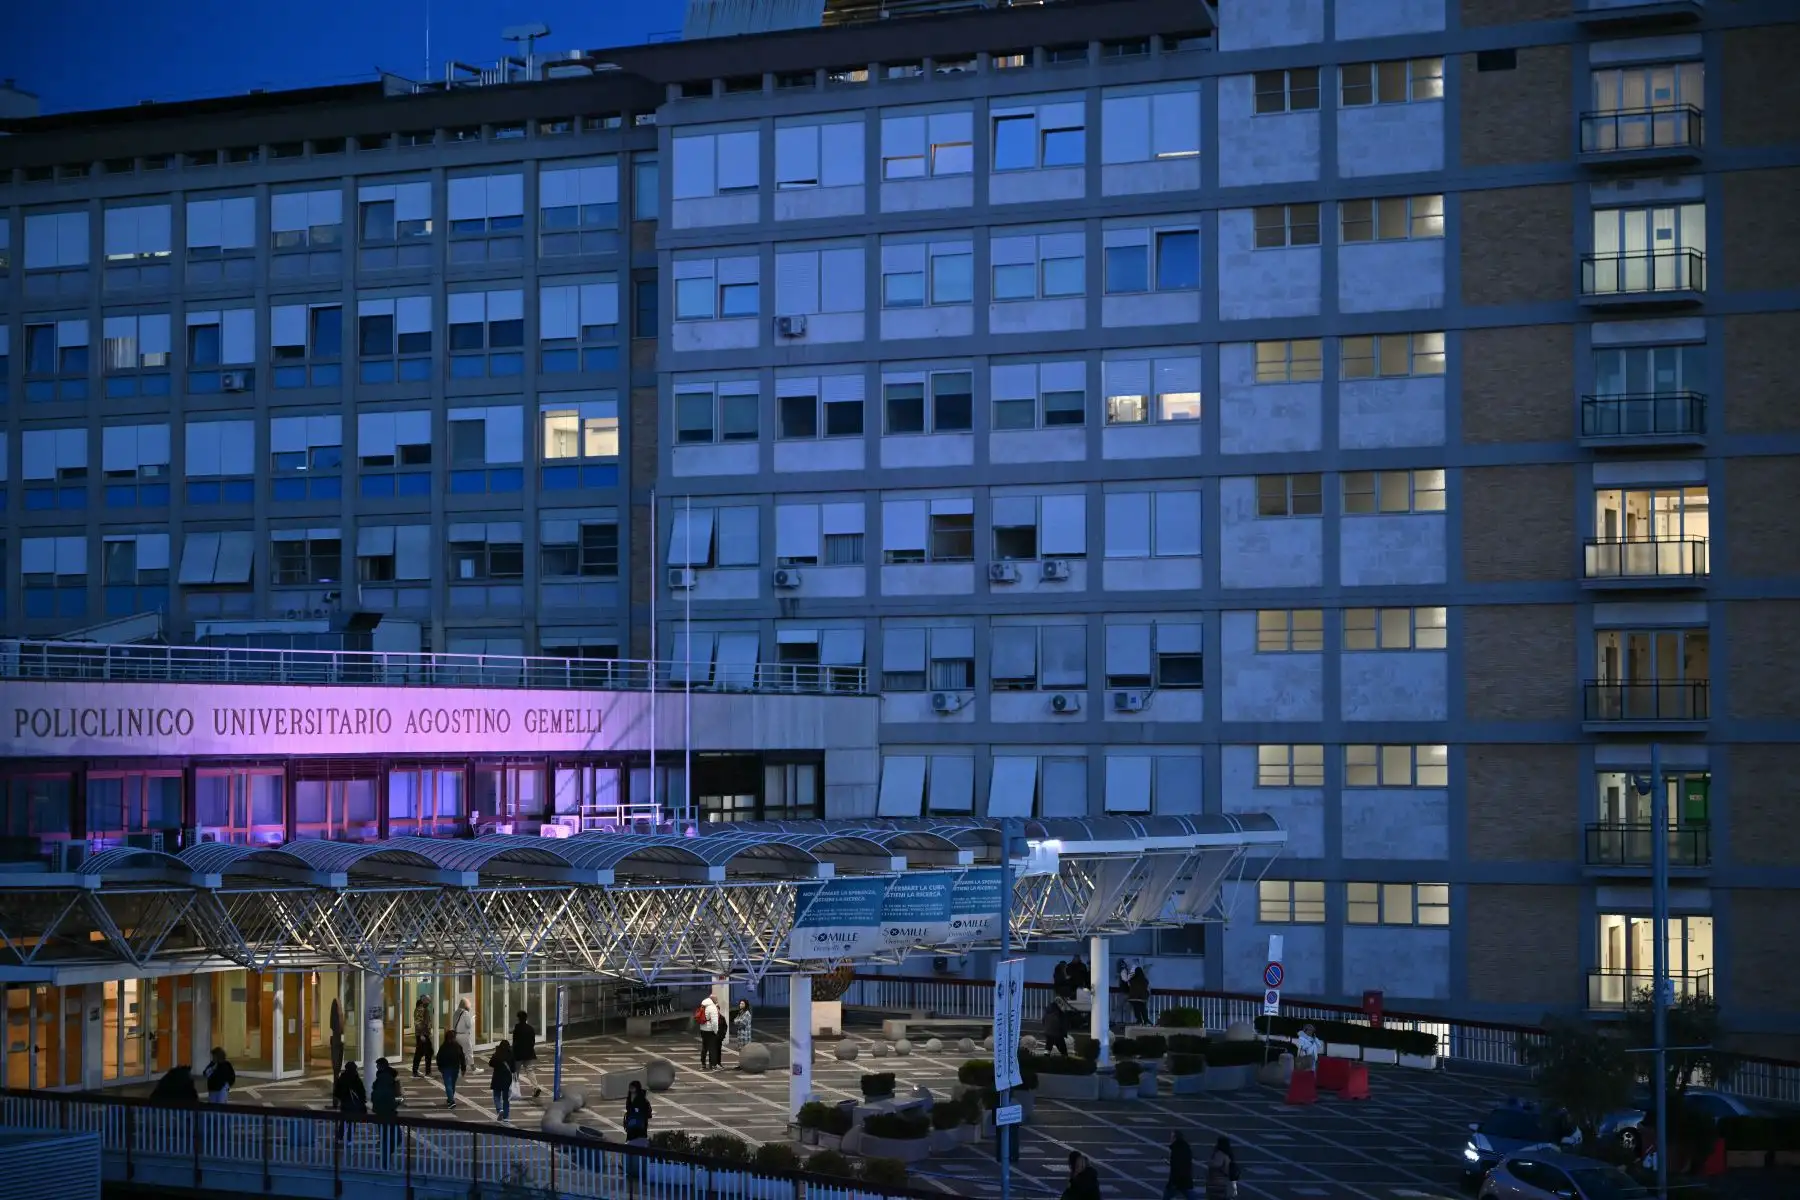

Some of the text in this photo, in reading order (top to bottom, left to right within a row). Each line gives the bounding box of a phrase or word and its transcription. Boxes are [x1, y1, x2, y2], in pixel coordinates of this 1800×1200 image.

[14, 708, 603, 737] POLICLINICO UNIVERSITARIO AGOSTINO GEMELLI
